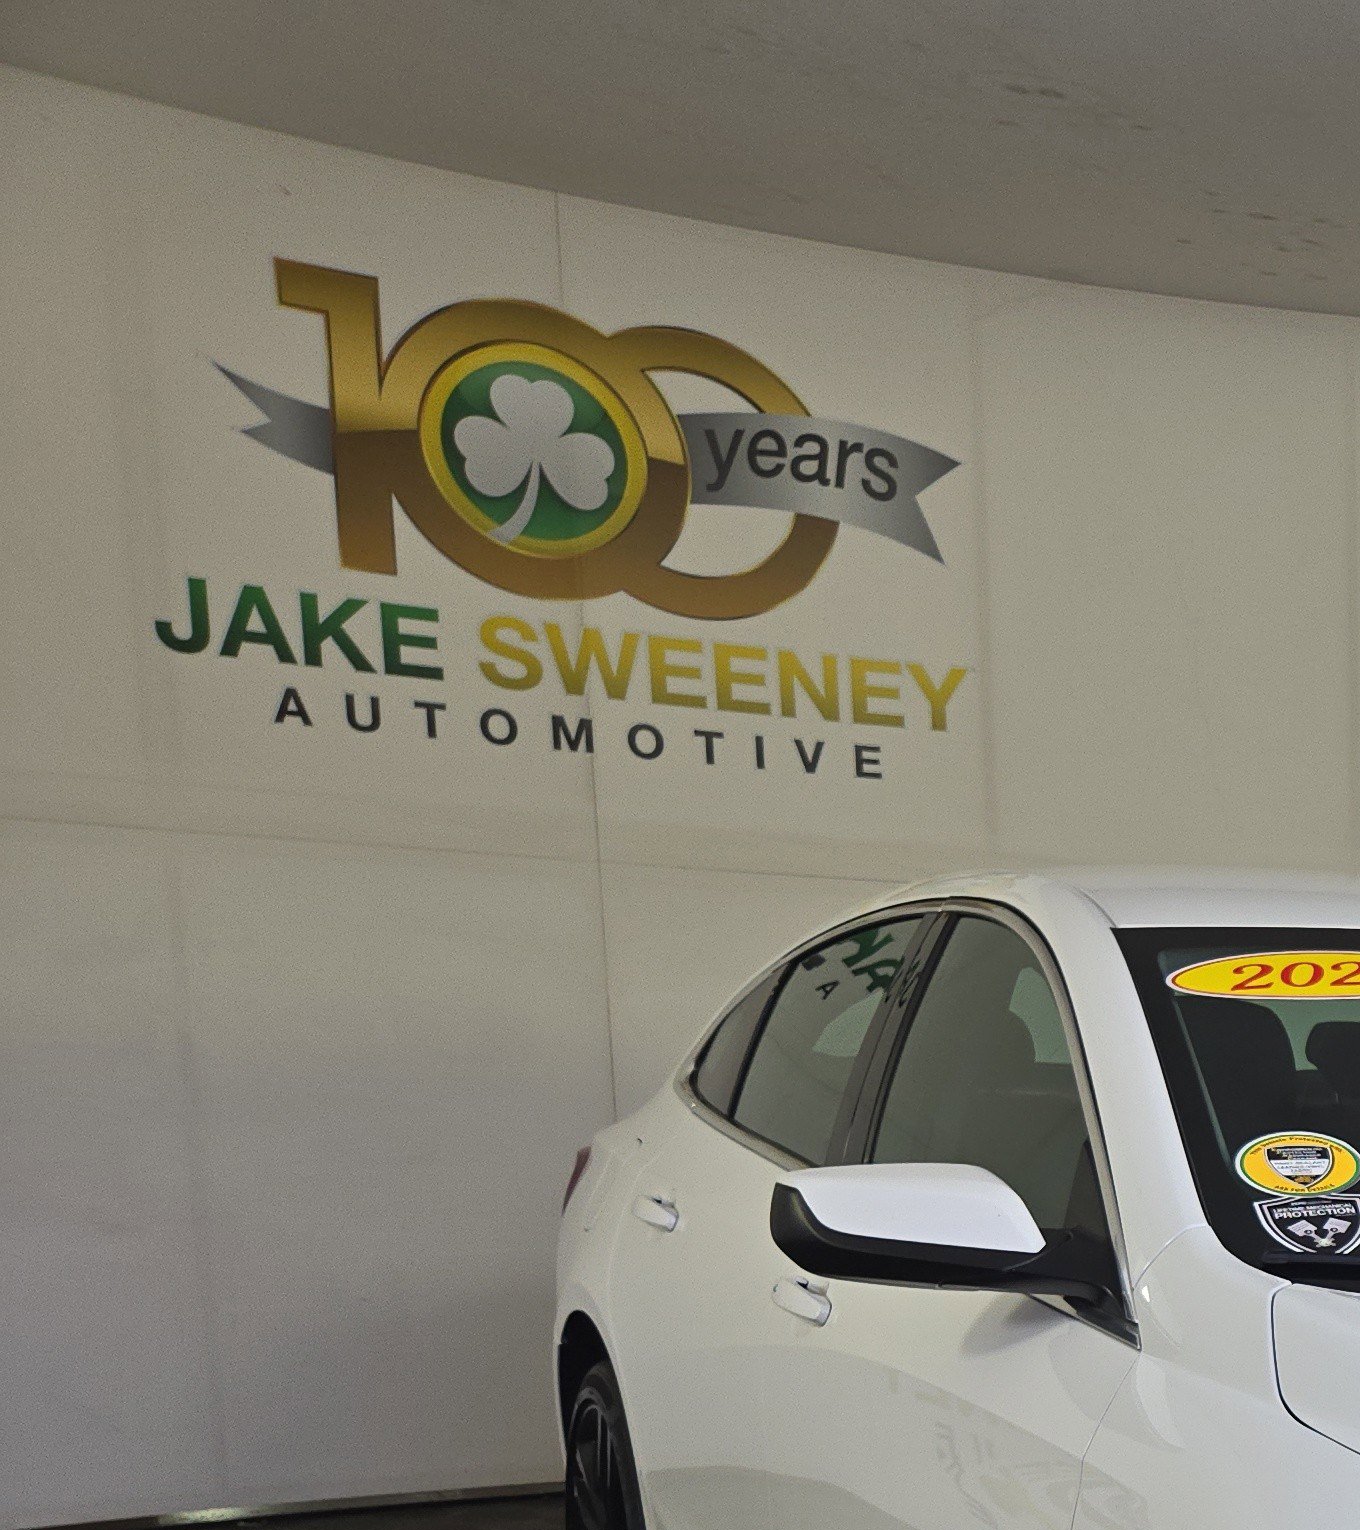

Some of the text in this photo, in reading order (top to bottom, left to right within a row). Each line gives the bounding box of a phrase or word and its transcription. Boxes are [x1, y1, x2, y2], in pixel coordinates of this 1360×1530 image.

[274, 256, 900, 621] 100 years
[154, 577, 968, 733] JAKE SWEENEY
[274, 688, 885, 780] AUTOMOTIVE
[1273, 1207, 1357, 1220] PROTECTION
